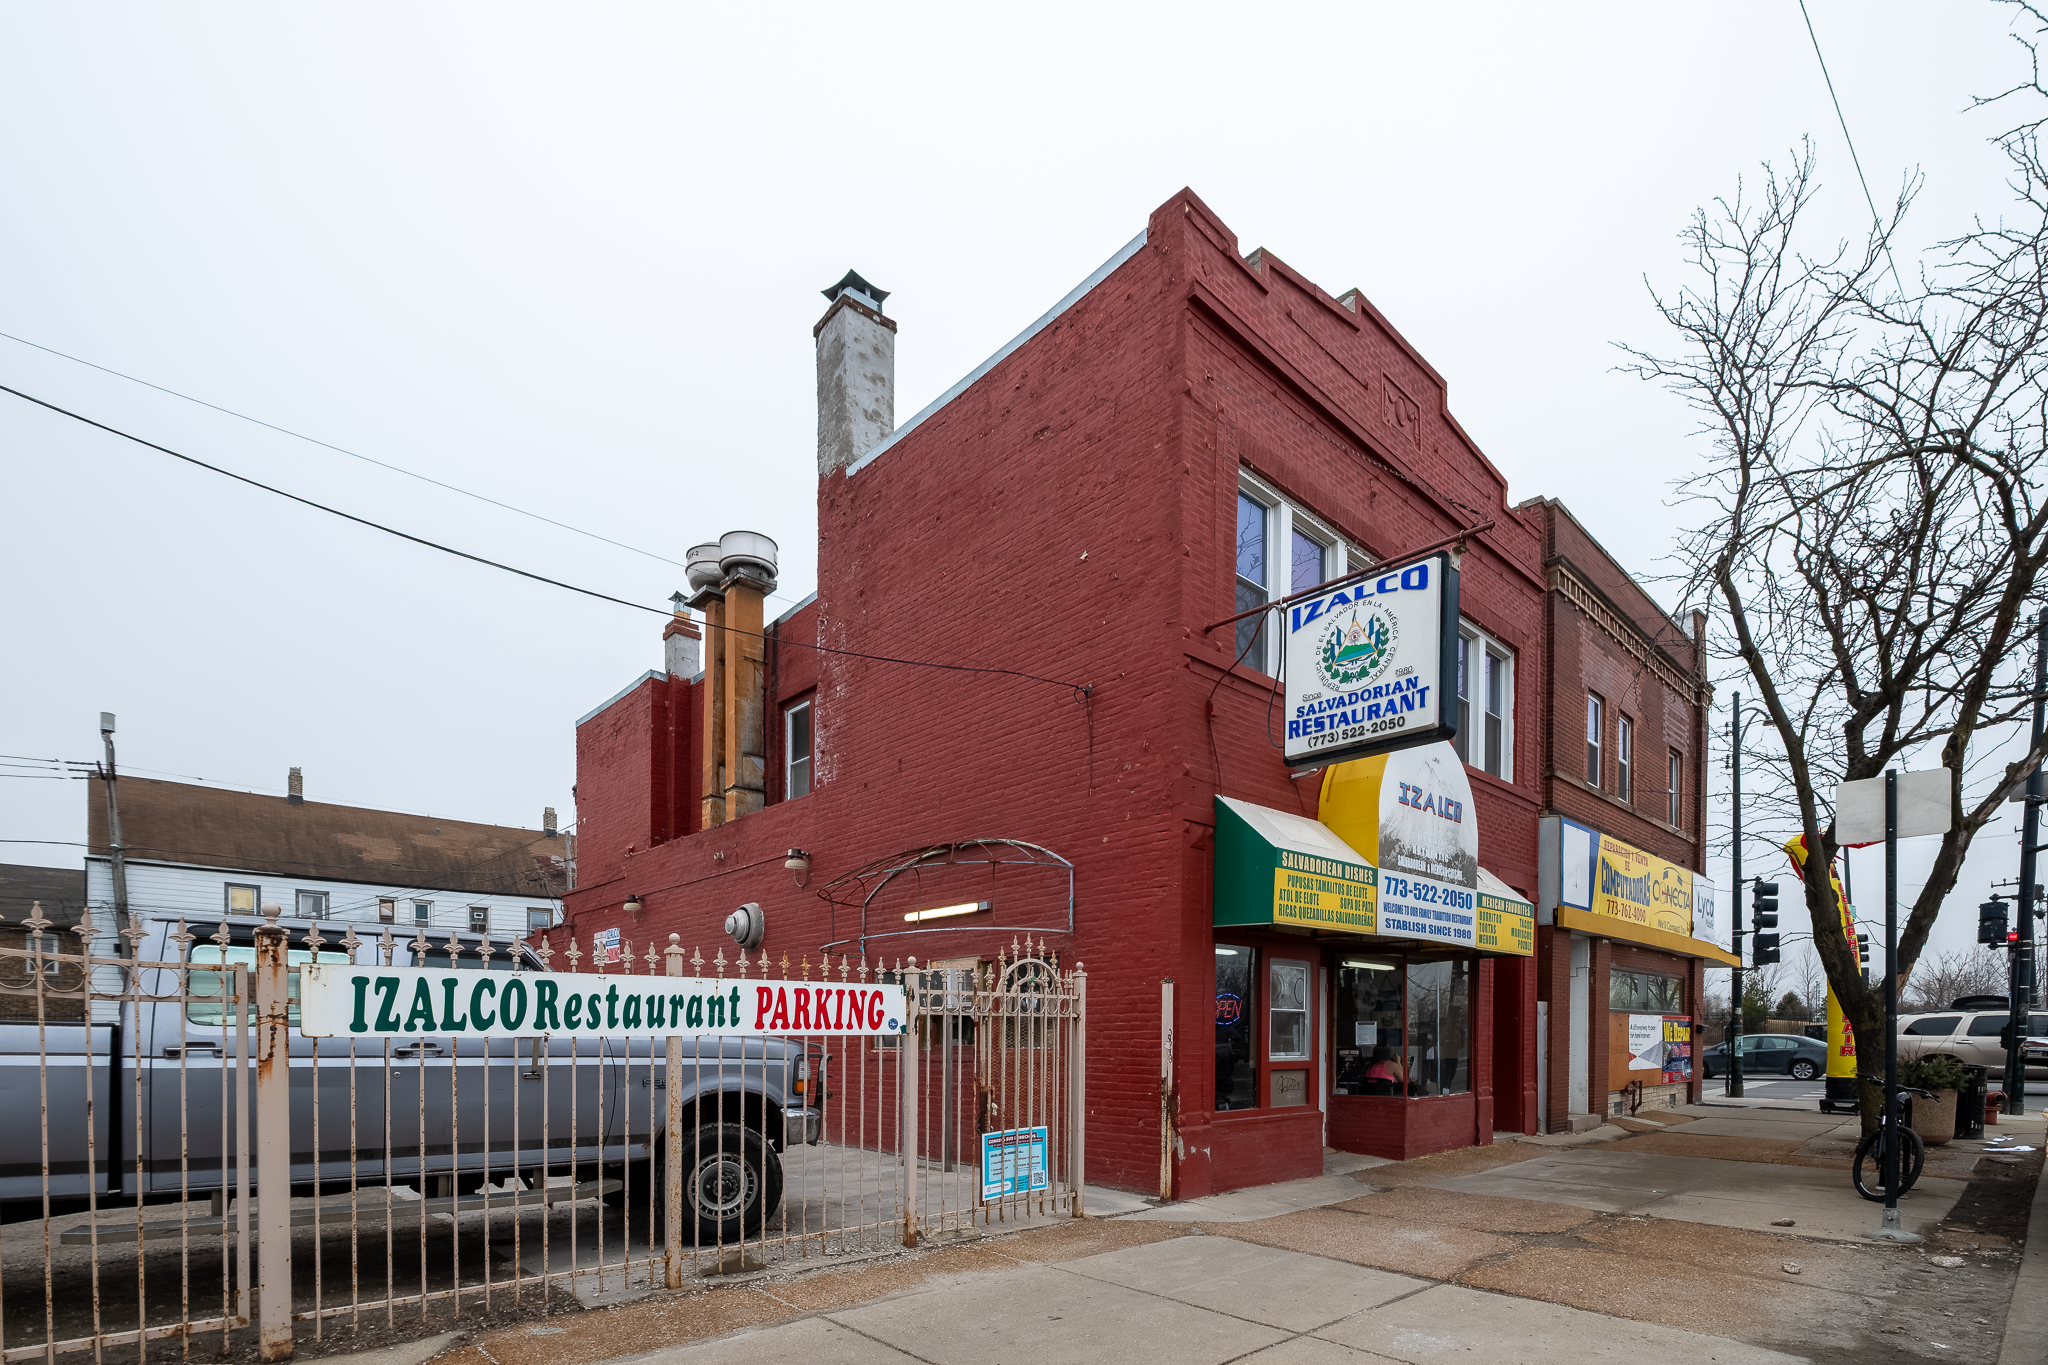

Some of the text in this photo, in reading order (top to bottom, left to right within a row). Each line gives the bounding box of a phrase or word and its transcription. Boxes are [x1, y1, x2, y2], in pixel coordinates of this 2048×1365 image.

[1292, 564, 1428, 633] IZALCO
[1316, 645, 1322, 655] DE
[1319, 634, 1326, 643] EL
[1324, 601, 1359, 632] SALVADOR
[1369, 646, 1396, 681] CENTRAL
[1296, 676, 1419, 718] SALVADORIAN
[1288, 686, 1430, 739] RESTAURANT
[1308, 716, 1406, 749] (773) 522-2050
[1398, 781, 1463, 824] IZALCO
[1282, 851, 1373, 883] SALVADOREAN DISHES
[1625, 860, 1630, 871] DE
[1635, 853, 1648, 867] VENTA
[1287, 874, 1368, 899] PUPUSAS TAMALITOS DE ELOTE
[1384, 876, 1473, 910] 773-522-2050
[1602, 856, 1651, 908] COMPUTADORAS
[1279, 888, 1319, 906] ATOL DE ELOTE
[1340, 897, 1374, 913] SOPA DE PATA
[1482, 895, 1531, 917] MEXICAN FAVORITES
[1279, 903, 1297, 918] RICAS
[1298, 905, 1334, 922] QUEZADILLAS
[1383, 902, 1404, 915] WELCOME
[1404, 905, 1409, 916] TO
[1410, 906, 1418, 917] OUR
[1419, 907, 1432, 919] FAMILY
[1432, 909, 1451, 923] TRADITION
[1479, 911, 1502, 924] BURRITOS
[1385, 918, 1472, 940] STABLISH SINCE 1980
[1479, 922, 1496, 934] TORTAS
[1479, 934, 1498, 946] MENUDO
[349, 976, 885, 1034] IZALCO Restaurant PARKING
